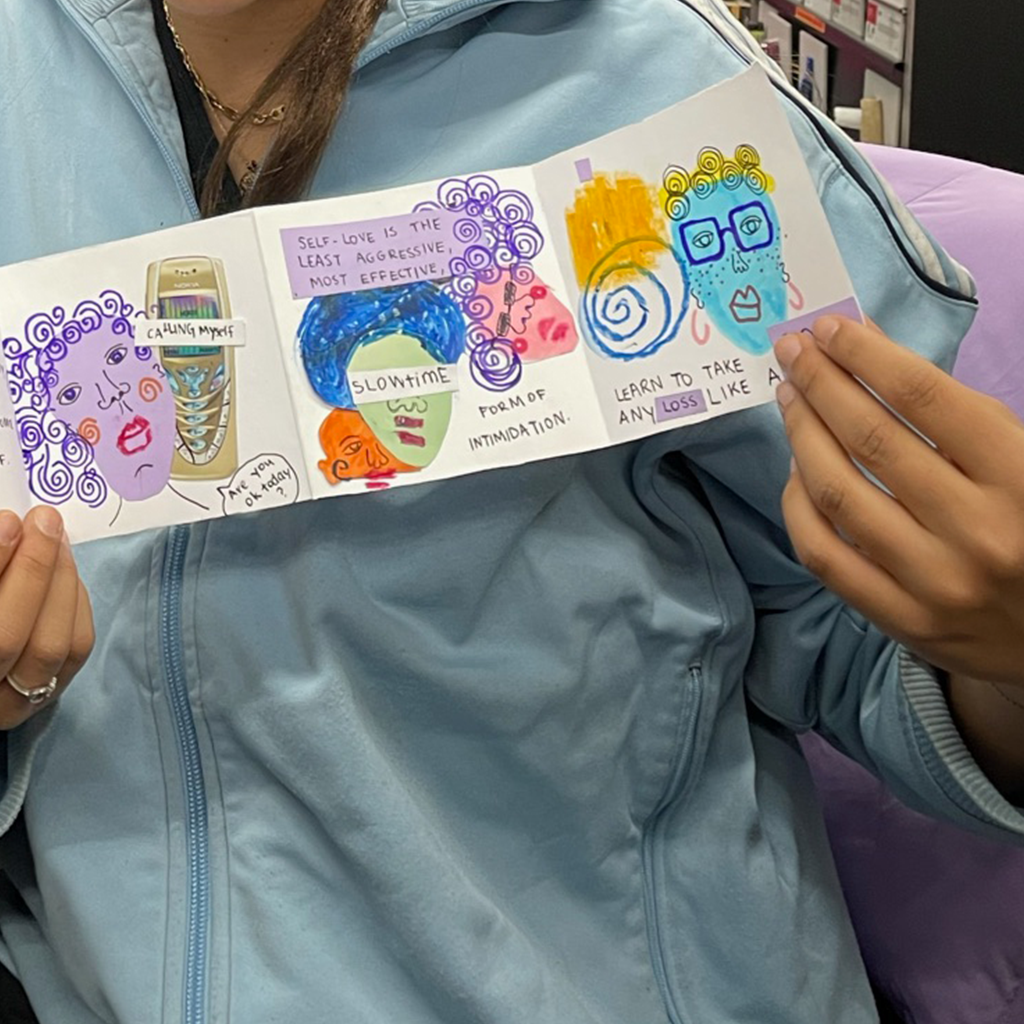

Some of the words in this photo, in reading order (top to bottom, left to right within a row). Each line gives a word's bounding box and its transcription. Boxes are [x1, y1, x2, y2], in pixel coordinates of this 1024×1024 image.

[298, 232, 375, 249] SELF-LOVE
[384, 226, 397, 238] IS
[409, 217, 441, 233] THE
[298, 255, 342, 268] LEAST
[356, 241, 453, 264] AGGRESSIVE,
[310, 274, 348, 289] MOST
[360, 263, 445, 284] EFFECTIVE,
[615, 375, 664, 403] LEARN
[670, 371, 693, 387] TO
[702, 358, 744, 380] TAKE
[478, 397, 525, 418] FORM
[527, 389, 546, 403] OF
[619, 405, 658, 426] ANY
[662, 395, 698, 413] LOSS
[706, 379, 751, 405] LIKE
[468, 411, 571, 451] INTIMIDATION.
